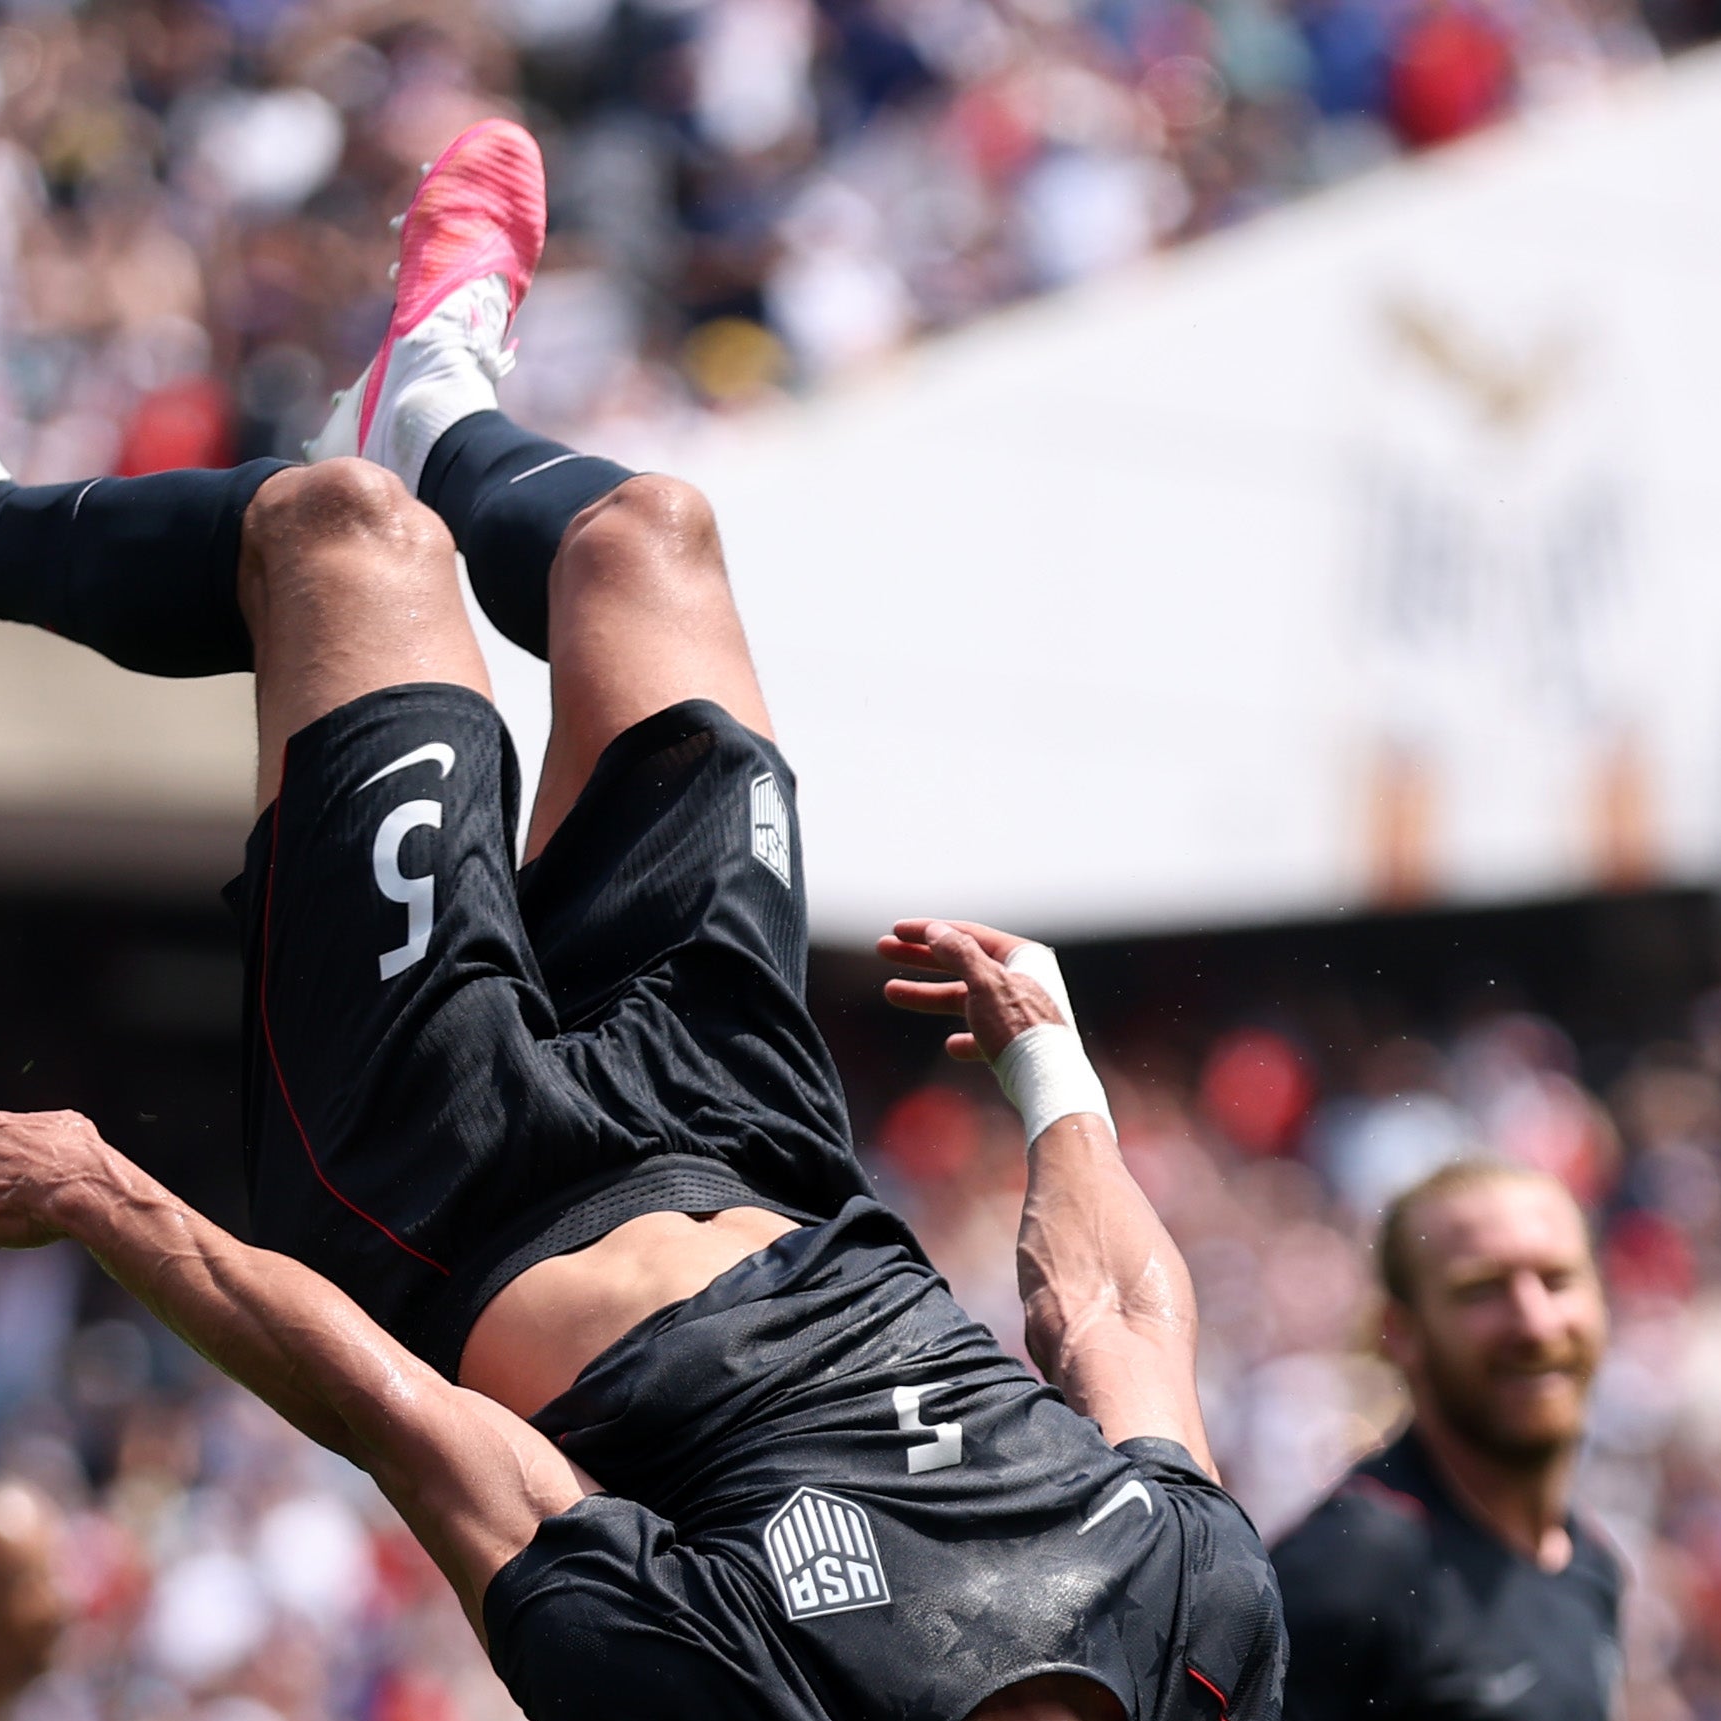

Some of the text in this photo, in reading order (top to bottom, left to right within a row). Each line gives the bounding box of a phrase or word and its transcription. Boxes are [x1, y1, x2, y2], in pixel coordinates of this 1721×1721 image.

[755, 826, 790, 881] USA
[372, 798, 444, 983] 5
[787, 1553, 881, 1611] USA
